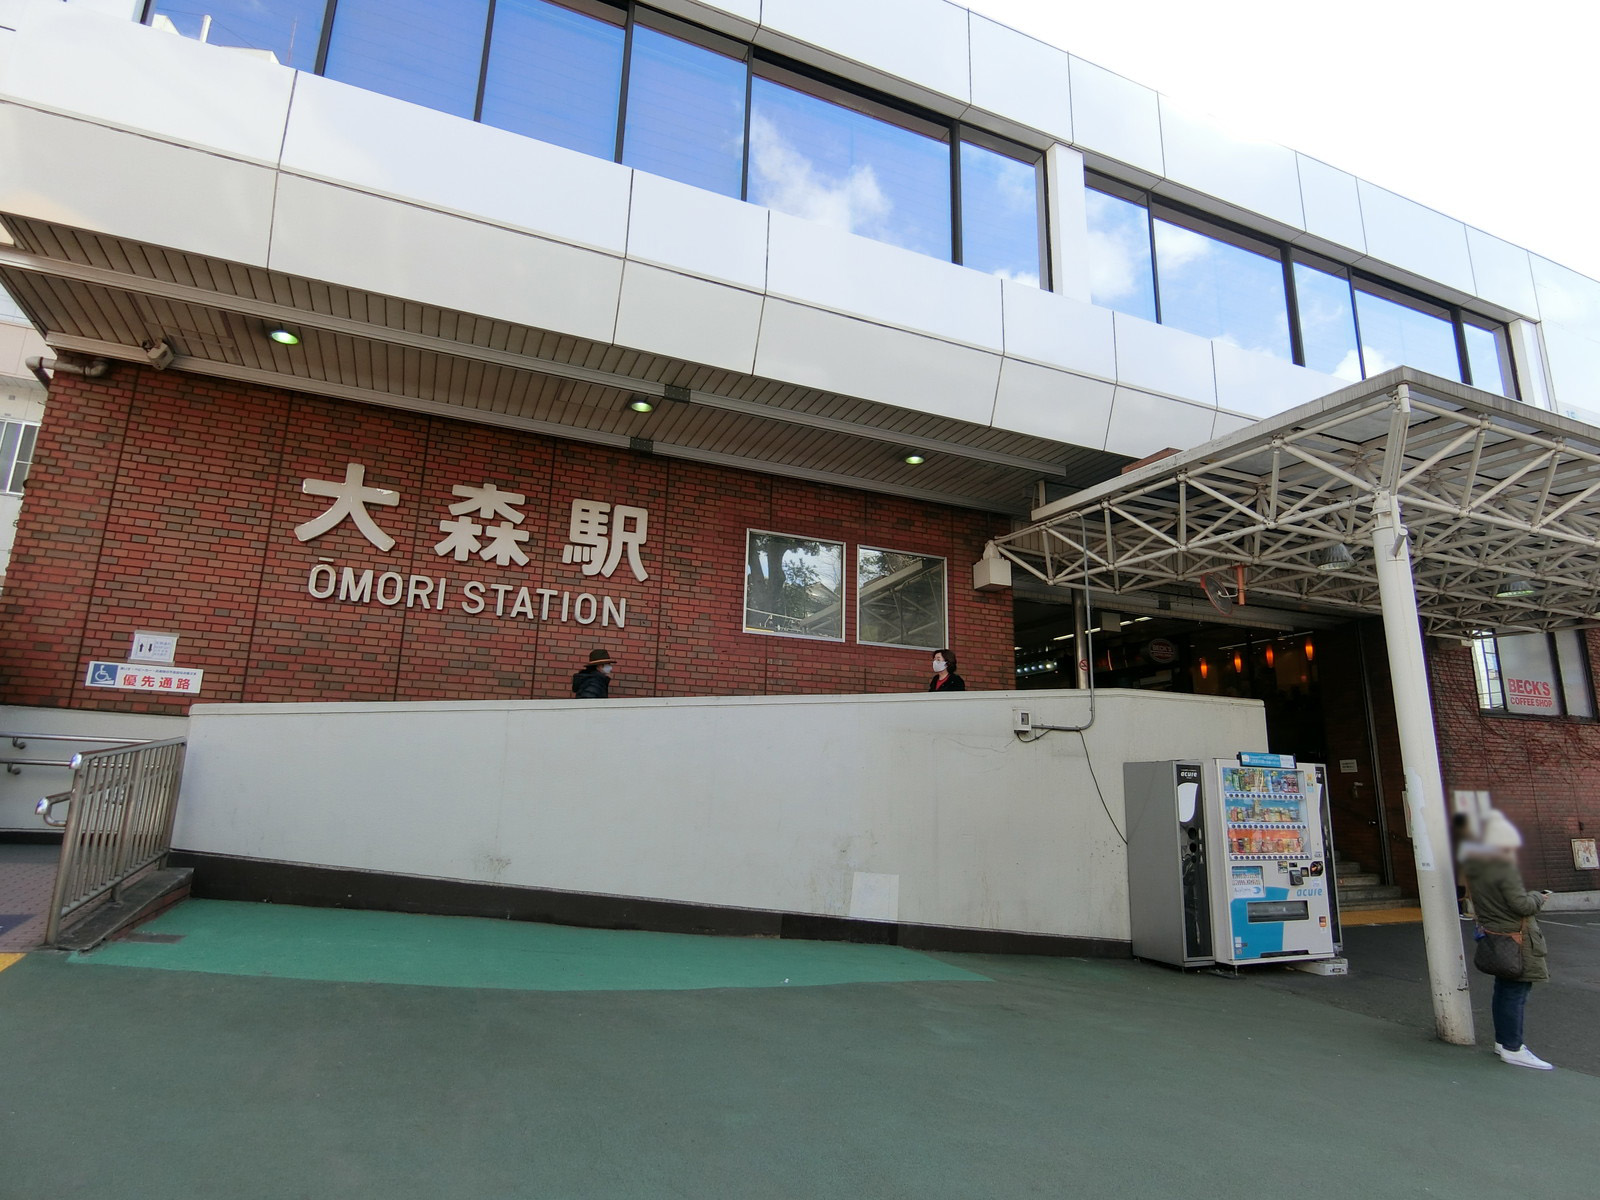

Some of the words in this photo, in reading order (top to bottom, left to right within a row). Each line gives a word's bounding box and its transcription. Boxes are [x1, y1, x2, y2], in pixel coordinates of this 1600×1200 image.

[293, 462, 649, 582] 大森駅
[461, 581, 627, 628] STATION
[123, 674, 191, 690] 優先通路
[1507, 679, 1551, 696] BECK'S
[1511, 697, 1535, 706] COFFEE
[1296, 887, 1323, 897] acure
